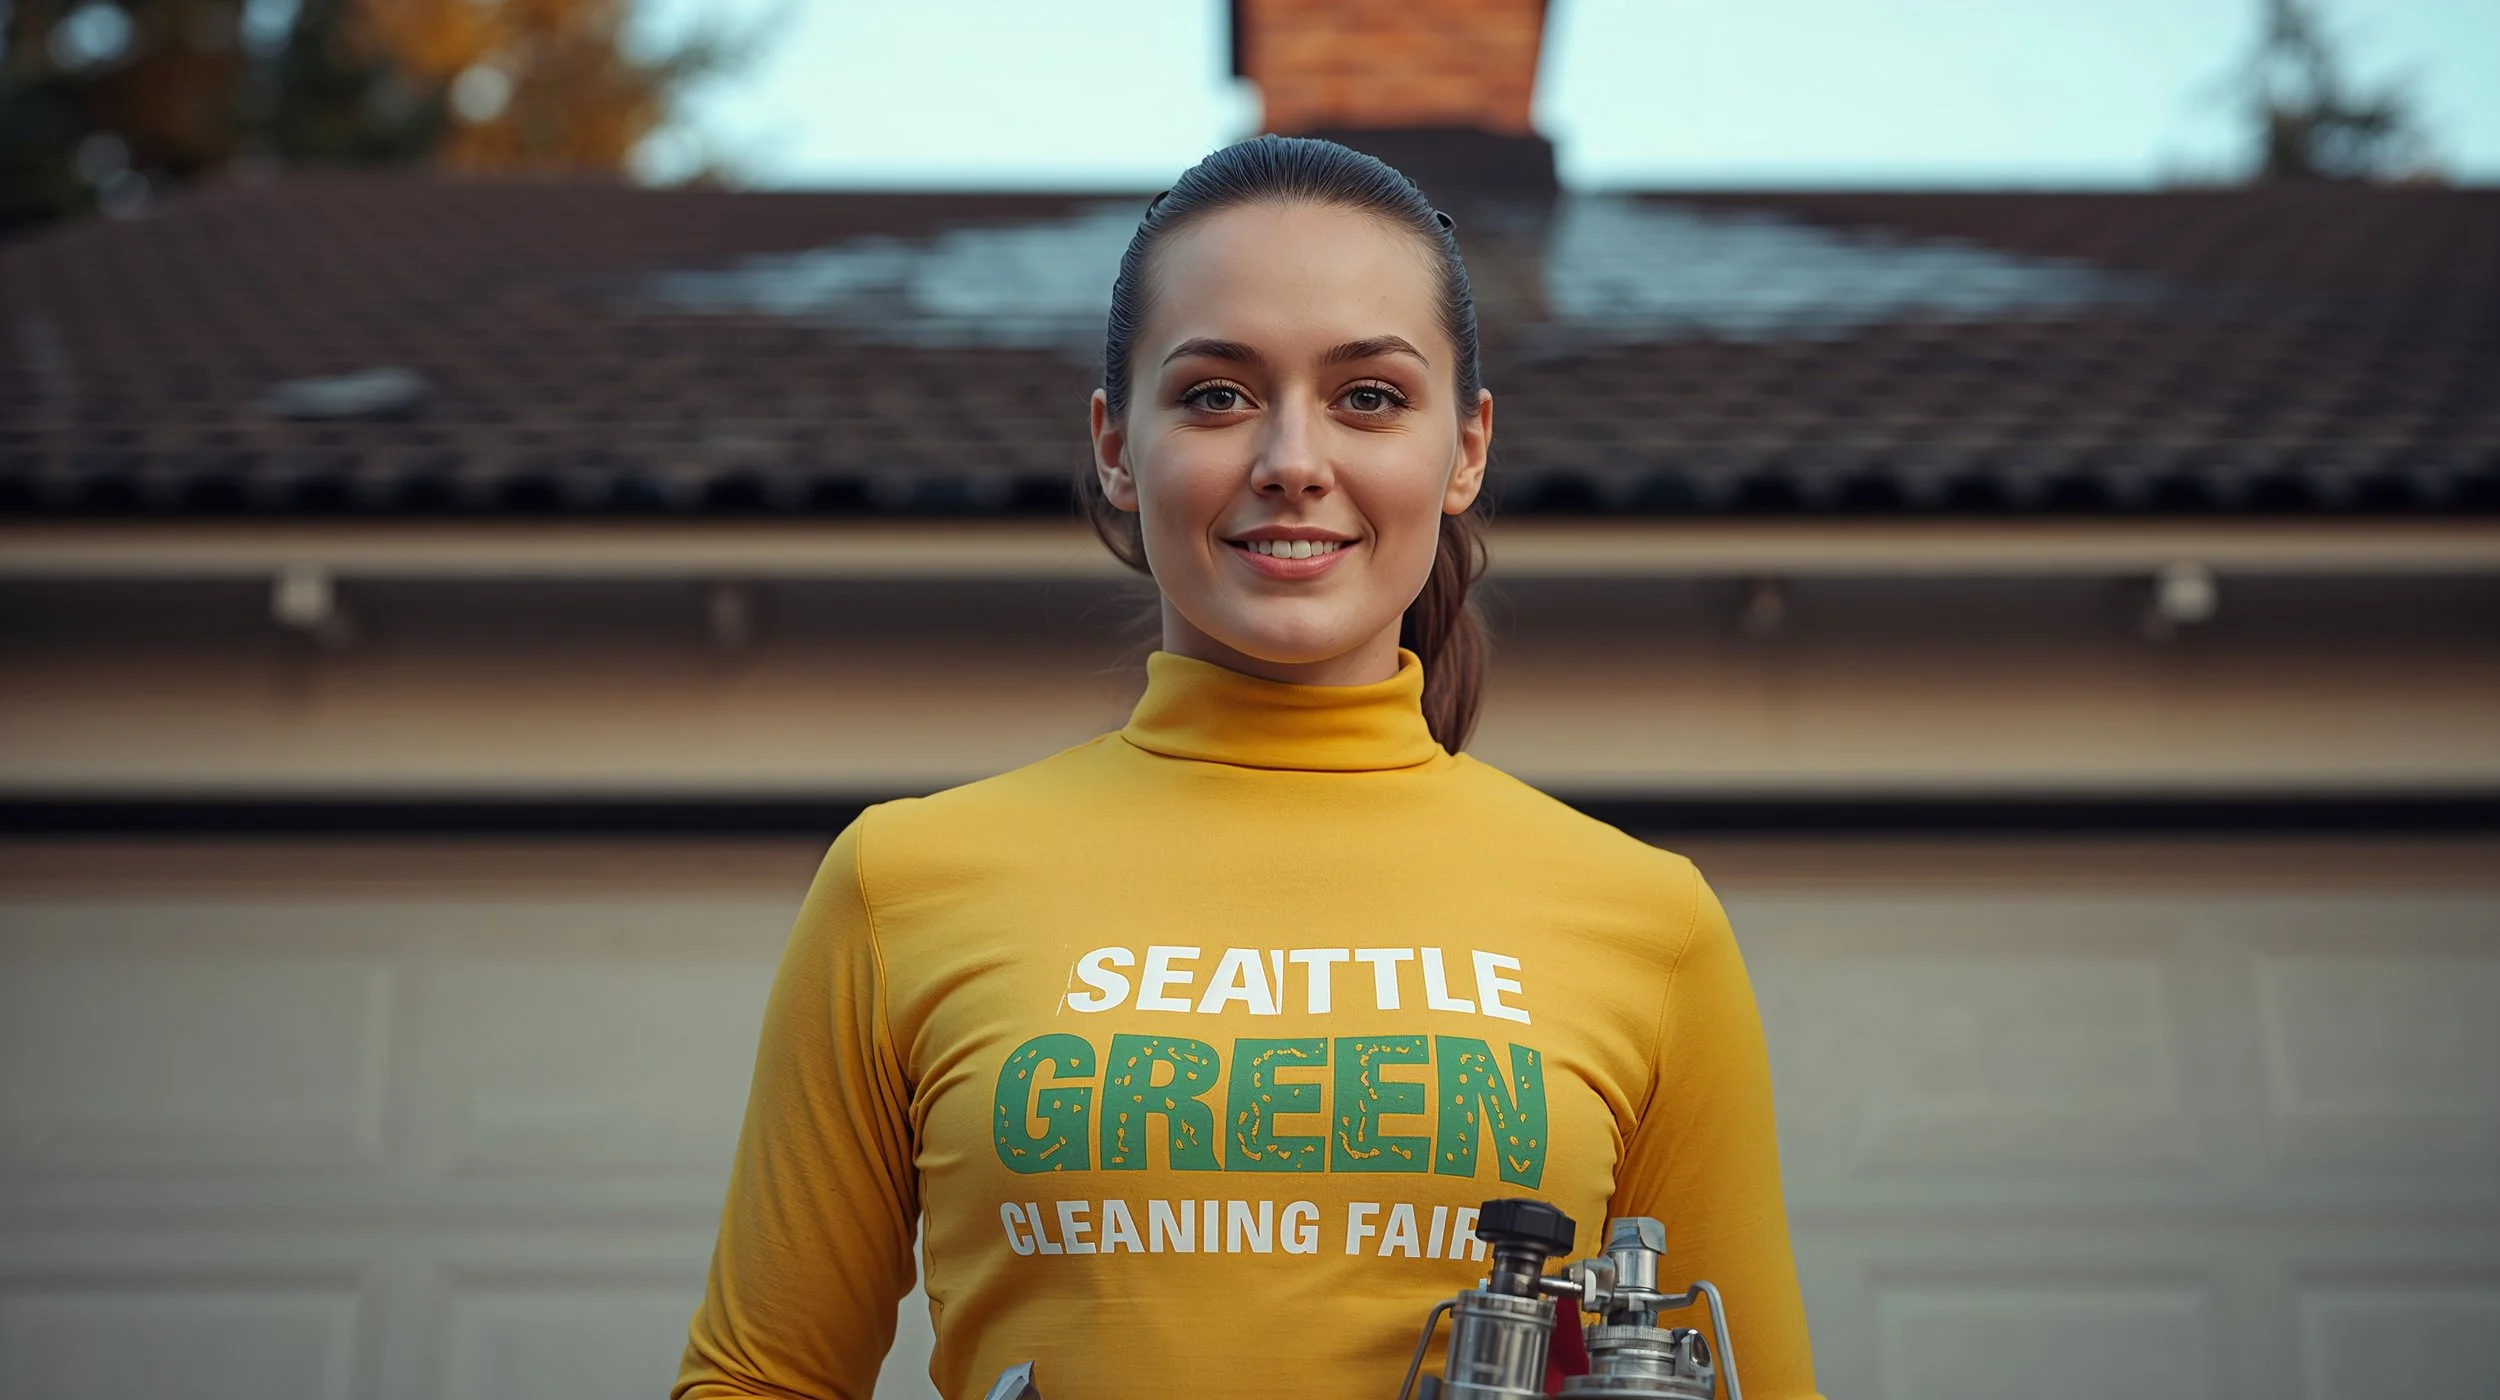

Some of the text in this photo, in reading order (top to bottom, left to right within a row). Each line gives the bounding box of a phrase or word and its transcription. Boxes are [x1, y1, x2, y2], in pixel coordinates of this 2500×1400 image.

[1067, 946, 1531, 1025] SEATTLE
[993, 1033, 1548, 1190] GREEN
[1000, 1199, 1319, 1256] CLEANING
